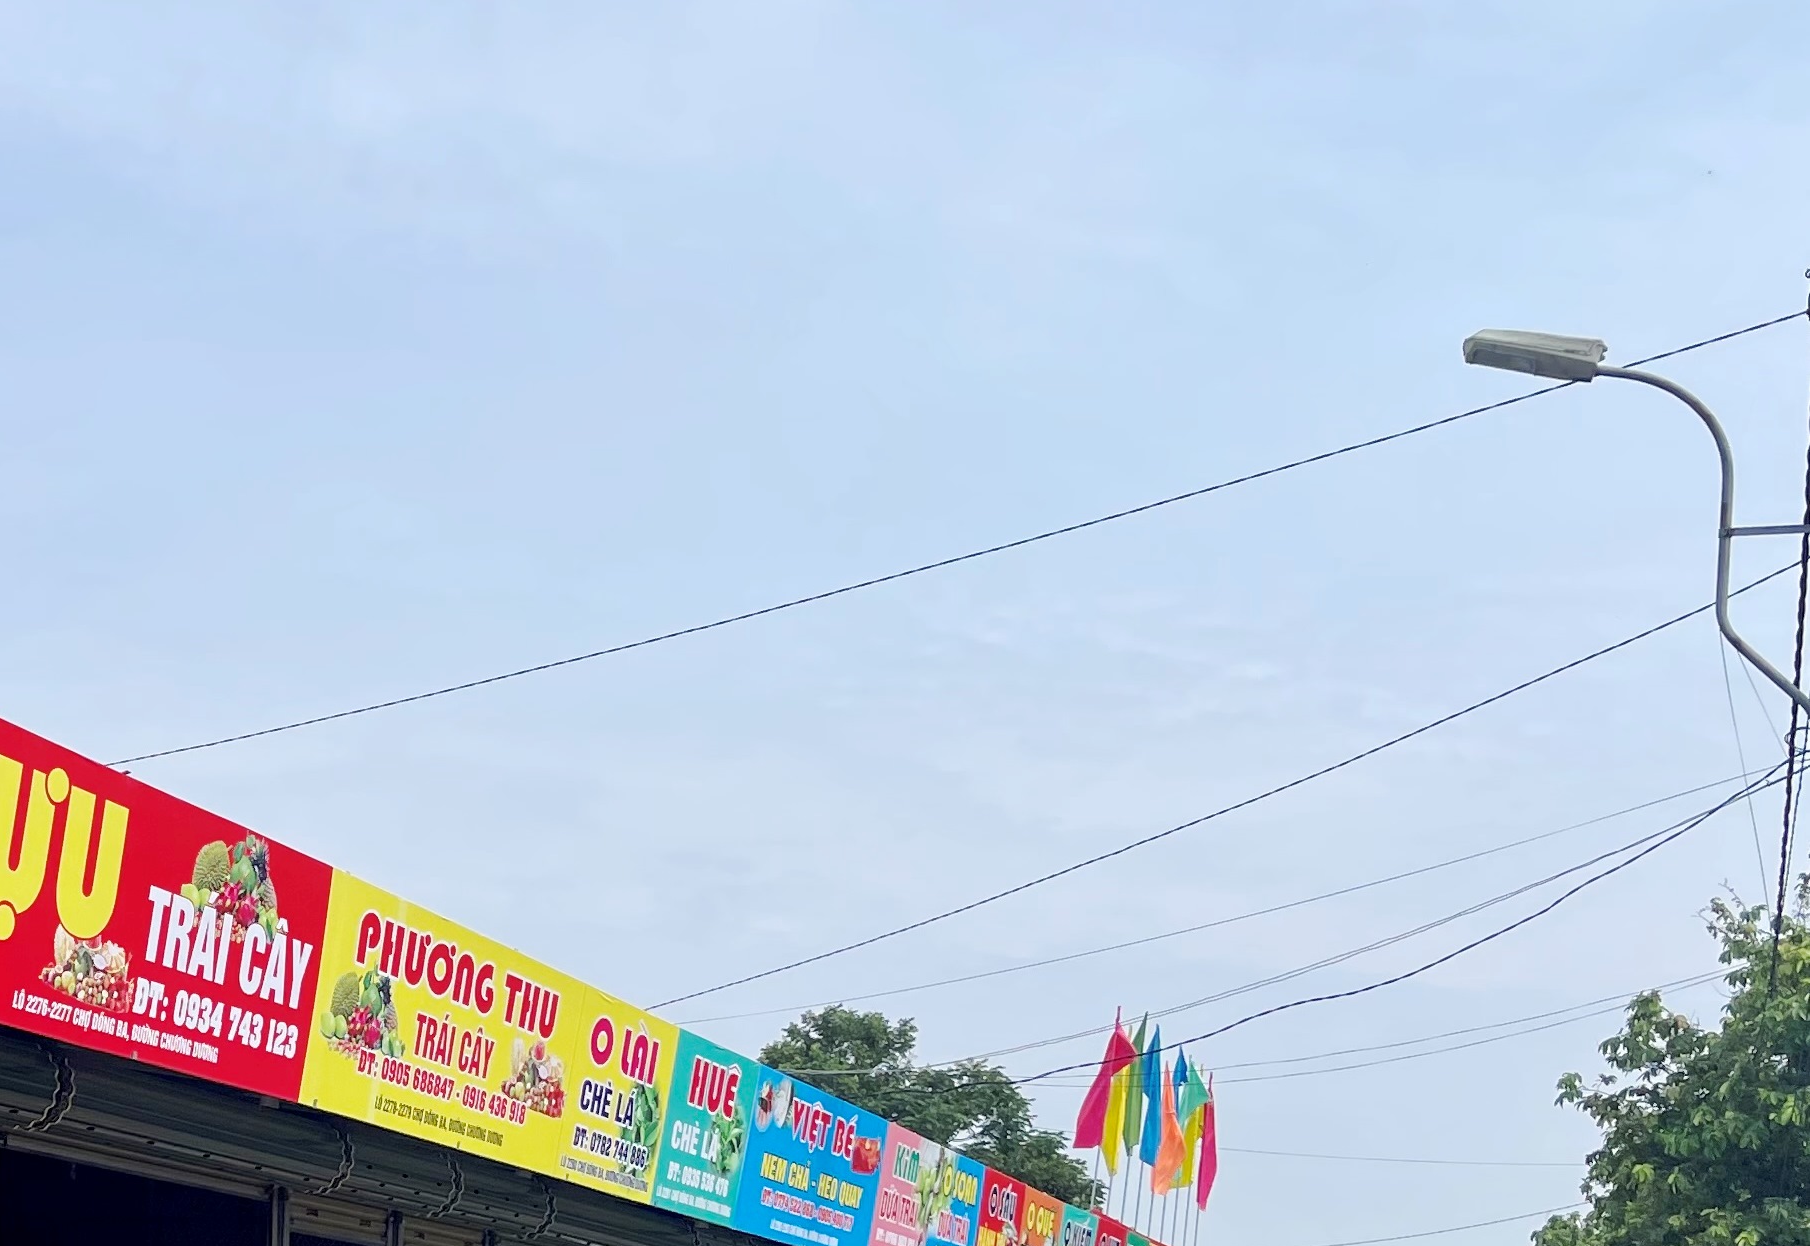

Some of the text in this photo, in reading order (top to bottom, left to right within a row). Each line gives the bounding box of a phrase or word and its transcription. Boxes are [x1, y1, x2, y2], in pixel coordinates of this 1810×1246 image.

[144, 884, 314, 1010] TRÁI CÂY
[356, 911, 559, 1039] PHƯƠNG THU
[12, 988, 26, 1011] LÔ
[26, 994, 73, 1023] 2276-2277
[72, 1007, 91, 1032] CHỢ
[132, 976, 299, 1060] ĐT: 0934 743 123
[413, 1012, 496, 1080] TRÁI CÂY
[590, 1017, 614, 1065] O
[357, 1049, 380, 1076] ĐT:
[380, 1058, 412, 1088] 0905
[412, 1066, 455, 1100] 686847
[462, 1084, 486, 1112] 0916
[489, 1096, 508, 1120] 436
[508, 1101, 526, 1126] 918
[580, 1079, 636, 1128] CHÈ LÁ
[590, 1131, 612, 1157] 0782
[613, 1140, 629, 1163] 744
[671, 1120, 720, 1163] CHÈ LÁ
[792, 1098, 858, 1161] VIỆT BÉ
[760, 1152, 788, 1184] NEM
[817, 1172, 839, 1201] HEO
[839, 1181, 864, 1209] QUAY
